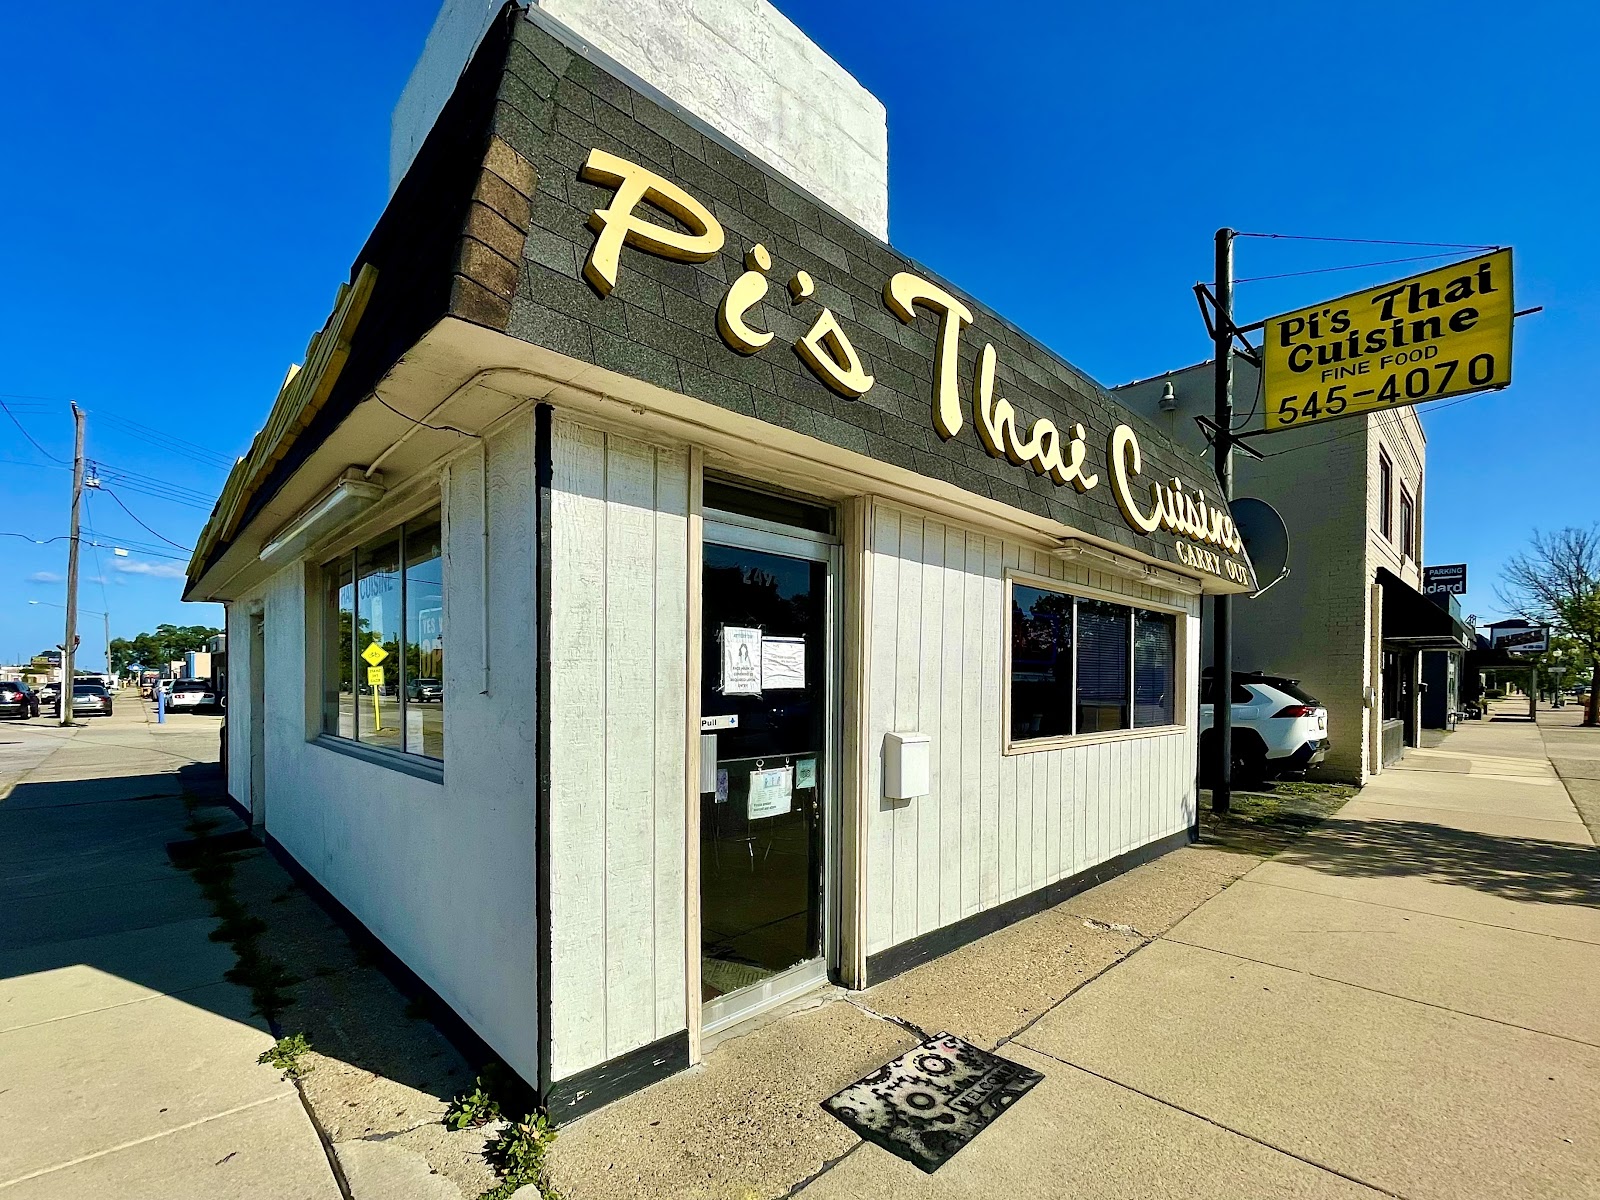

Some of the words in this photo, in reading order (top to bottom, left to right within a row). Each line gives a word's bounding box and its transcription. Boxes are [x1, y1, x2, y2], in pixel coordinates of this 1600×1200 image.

[1277, 308, 1351, 348] Pi's
[1371, 262, 1498, 322] Thai
[580, 147, 874, 399] Pi's
[882, 271, 1098, 494] Thai
[1106, 424, 1242, 555] Cuisine
[1287, 307, 1479, 373] Cuisine
[1321, 360, 1371, 383] FINE
[1380, 345, 1438, 370] FOOD
[1278, 353, 1495, 425] 545-4070
[1175, 540, 1222, 576] CARRY
[1224, 558, 1249, 586] OUT
[1429, 567, 1463, 575] PARKING
[422, 617, 436, 635] YES
[701, 719, 717, 727] Pull
